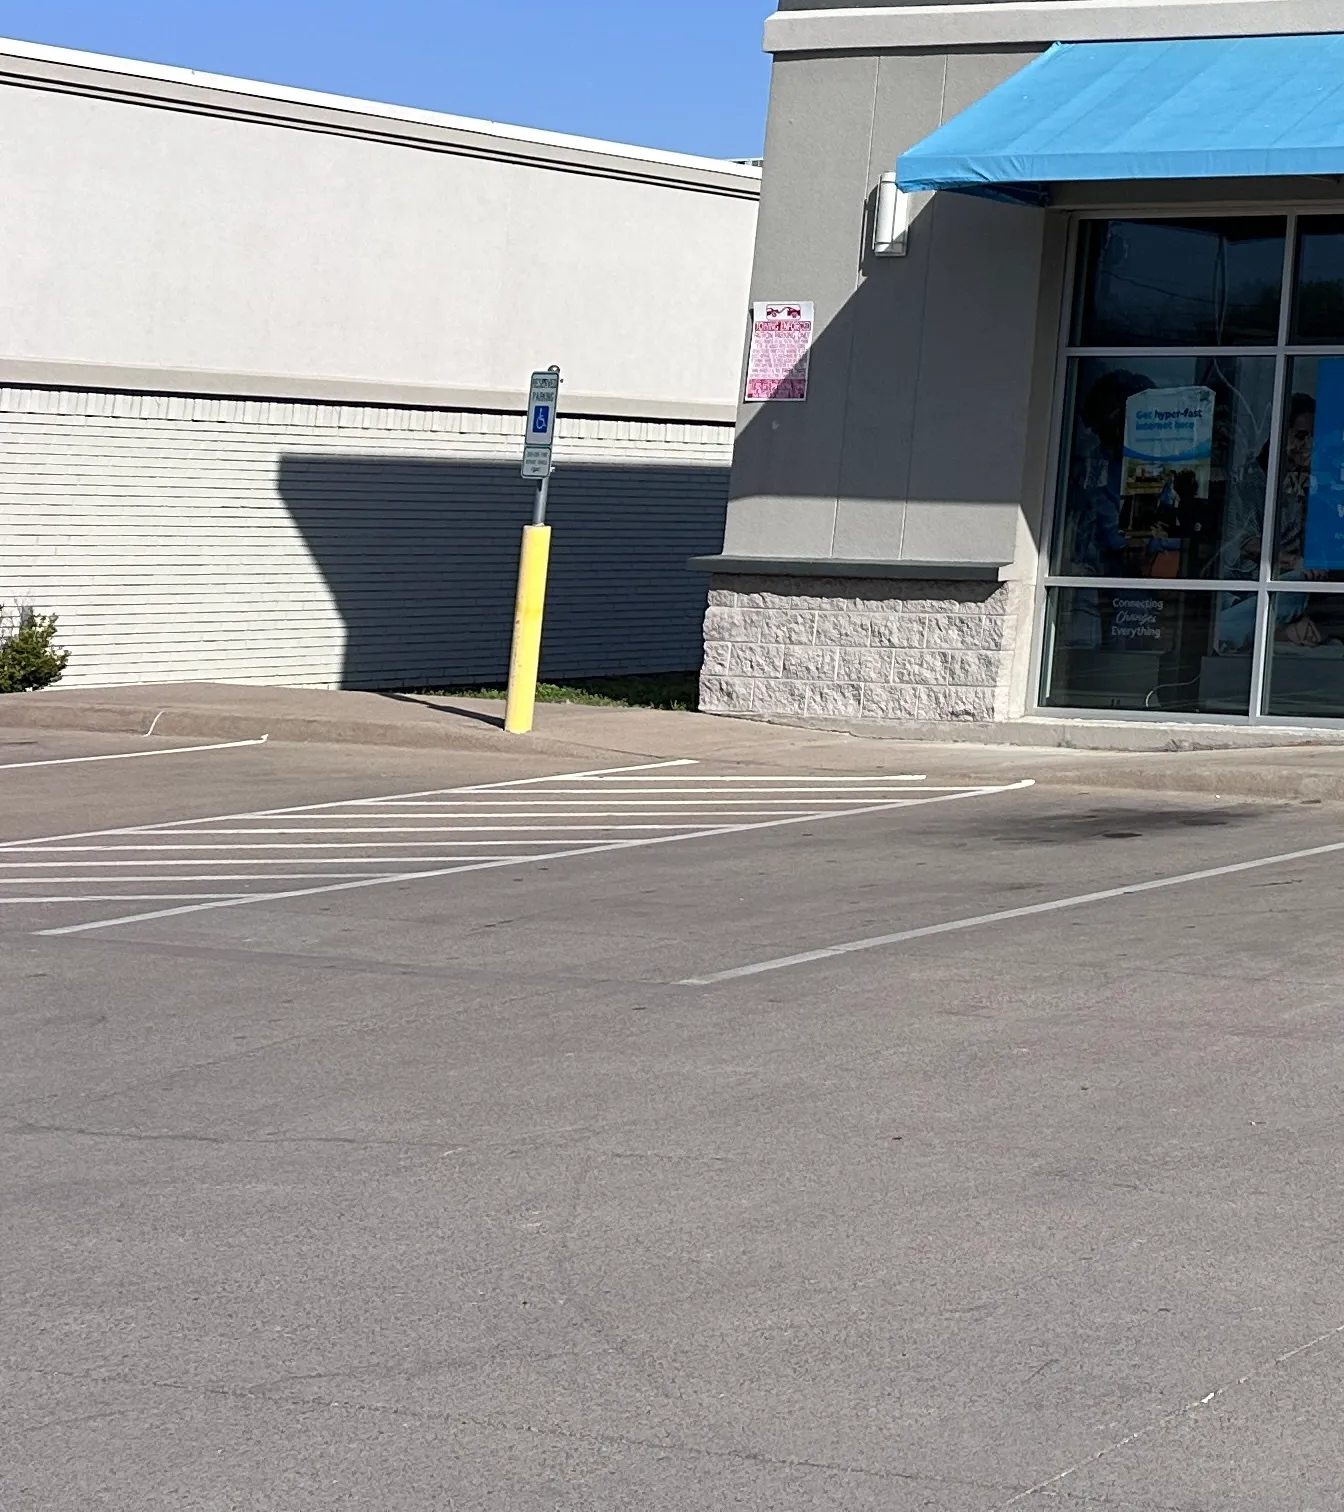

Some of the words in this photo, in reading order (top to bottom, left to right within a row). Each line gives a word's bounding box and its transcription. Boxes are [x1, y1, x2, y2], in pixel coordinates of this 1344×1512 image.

[1154, 408, 1203, 421] hyper-fast
[1112, 597, 1164, 610] Connecting
[1111, 626, 1161, 639] Everything
